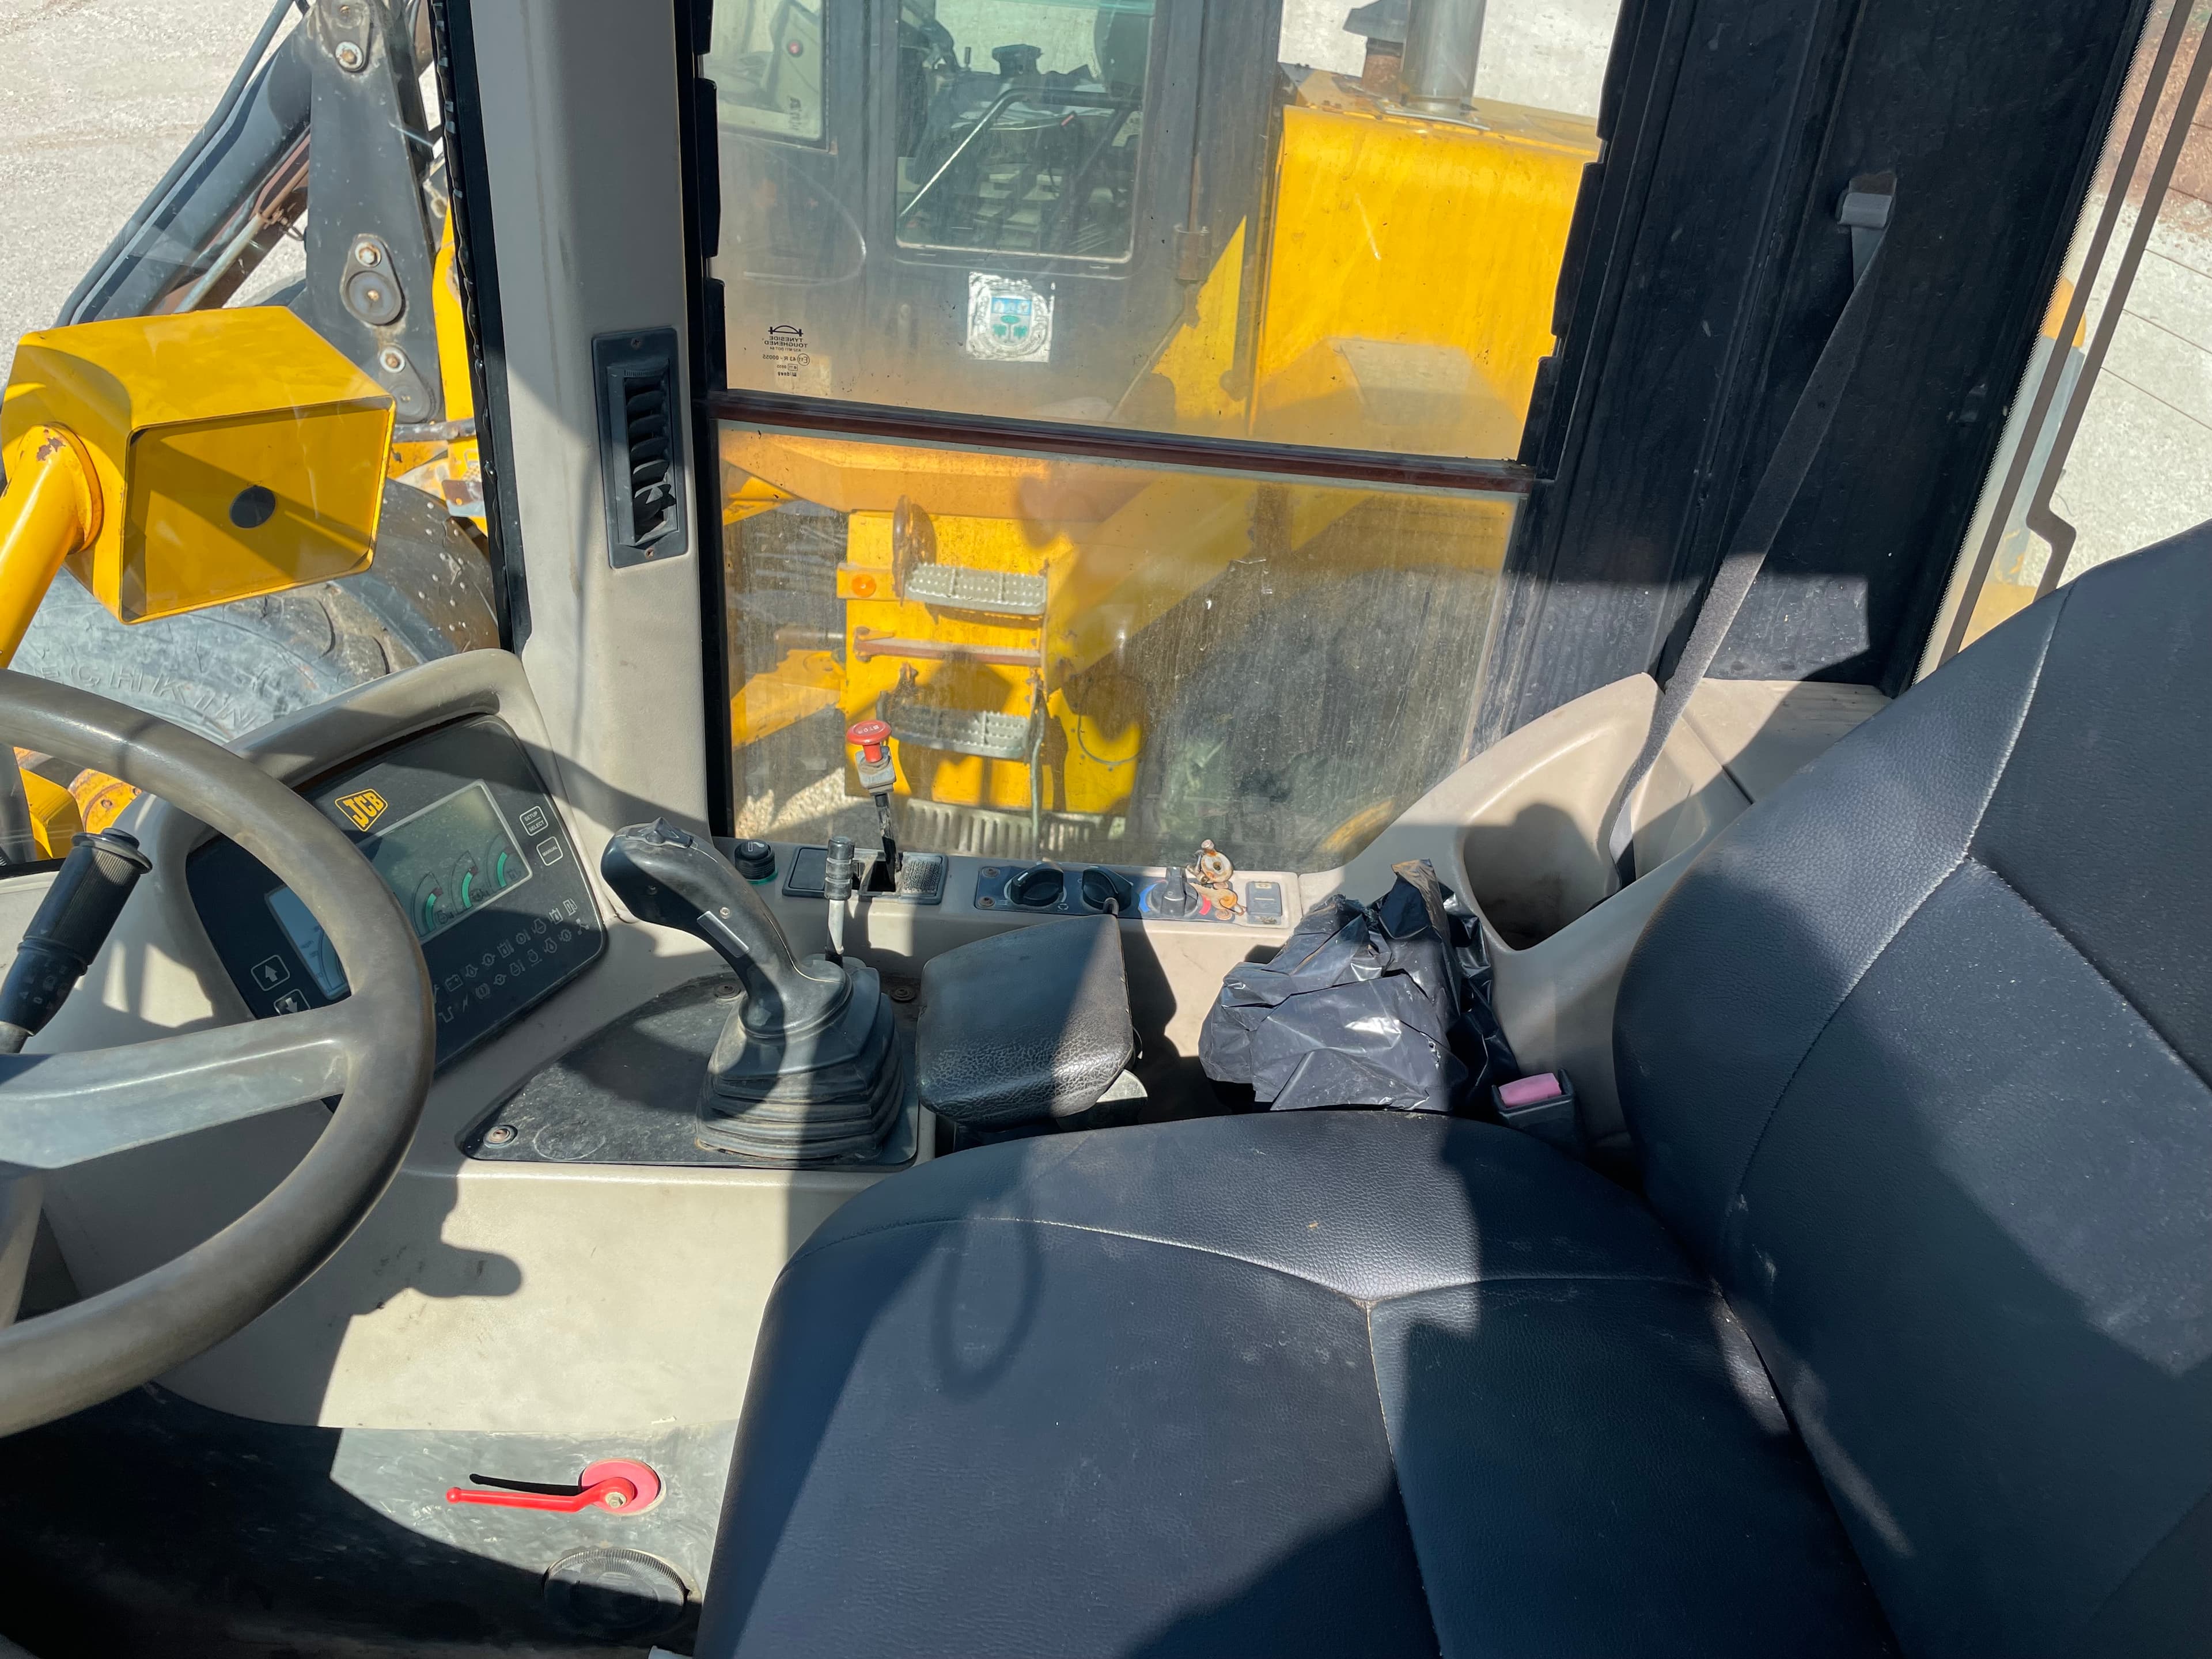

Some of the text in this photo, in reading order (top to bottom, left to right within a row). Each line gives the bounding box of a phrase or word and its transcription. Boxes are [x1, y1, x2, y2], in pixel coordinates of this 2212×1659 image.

[343, 793, 384, 827] JCB
[524, 811, 538, 821] SETUP
[528, 820, 544, 832] SELECT
[542, 846, 558, 857] MANUAL
